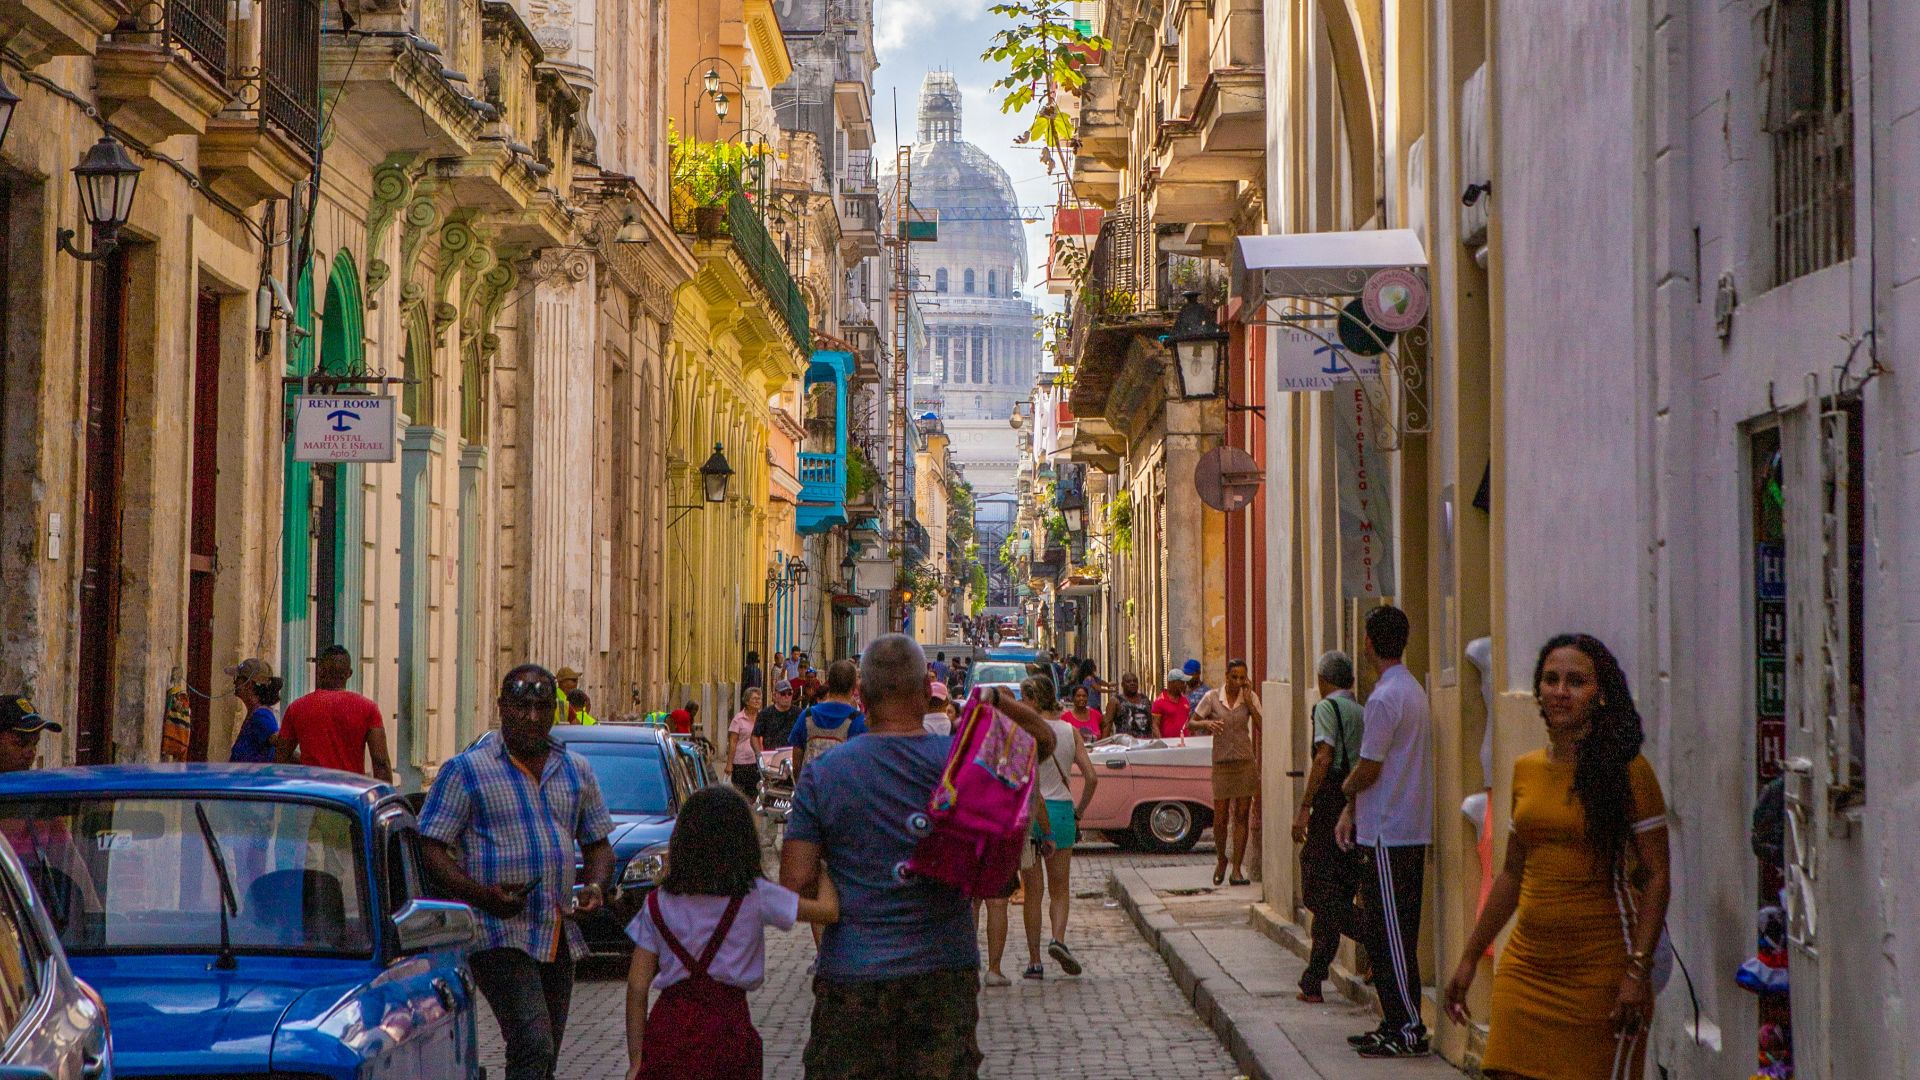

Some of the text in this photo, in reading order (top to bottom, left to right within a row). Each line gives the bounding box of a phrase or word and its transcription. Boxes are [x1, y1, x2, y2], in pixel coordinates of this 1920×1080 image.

[308, 399, 381, 409] RENT ROOM
[324, 434, 362, 442] HOSTAL
[303, 442, 385, 450] MARTA E ISRAEL
[330, 449, 358, 458] Apto 2
[97, 831, 117, 849] 17
